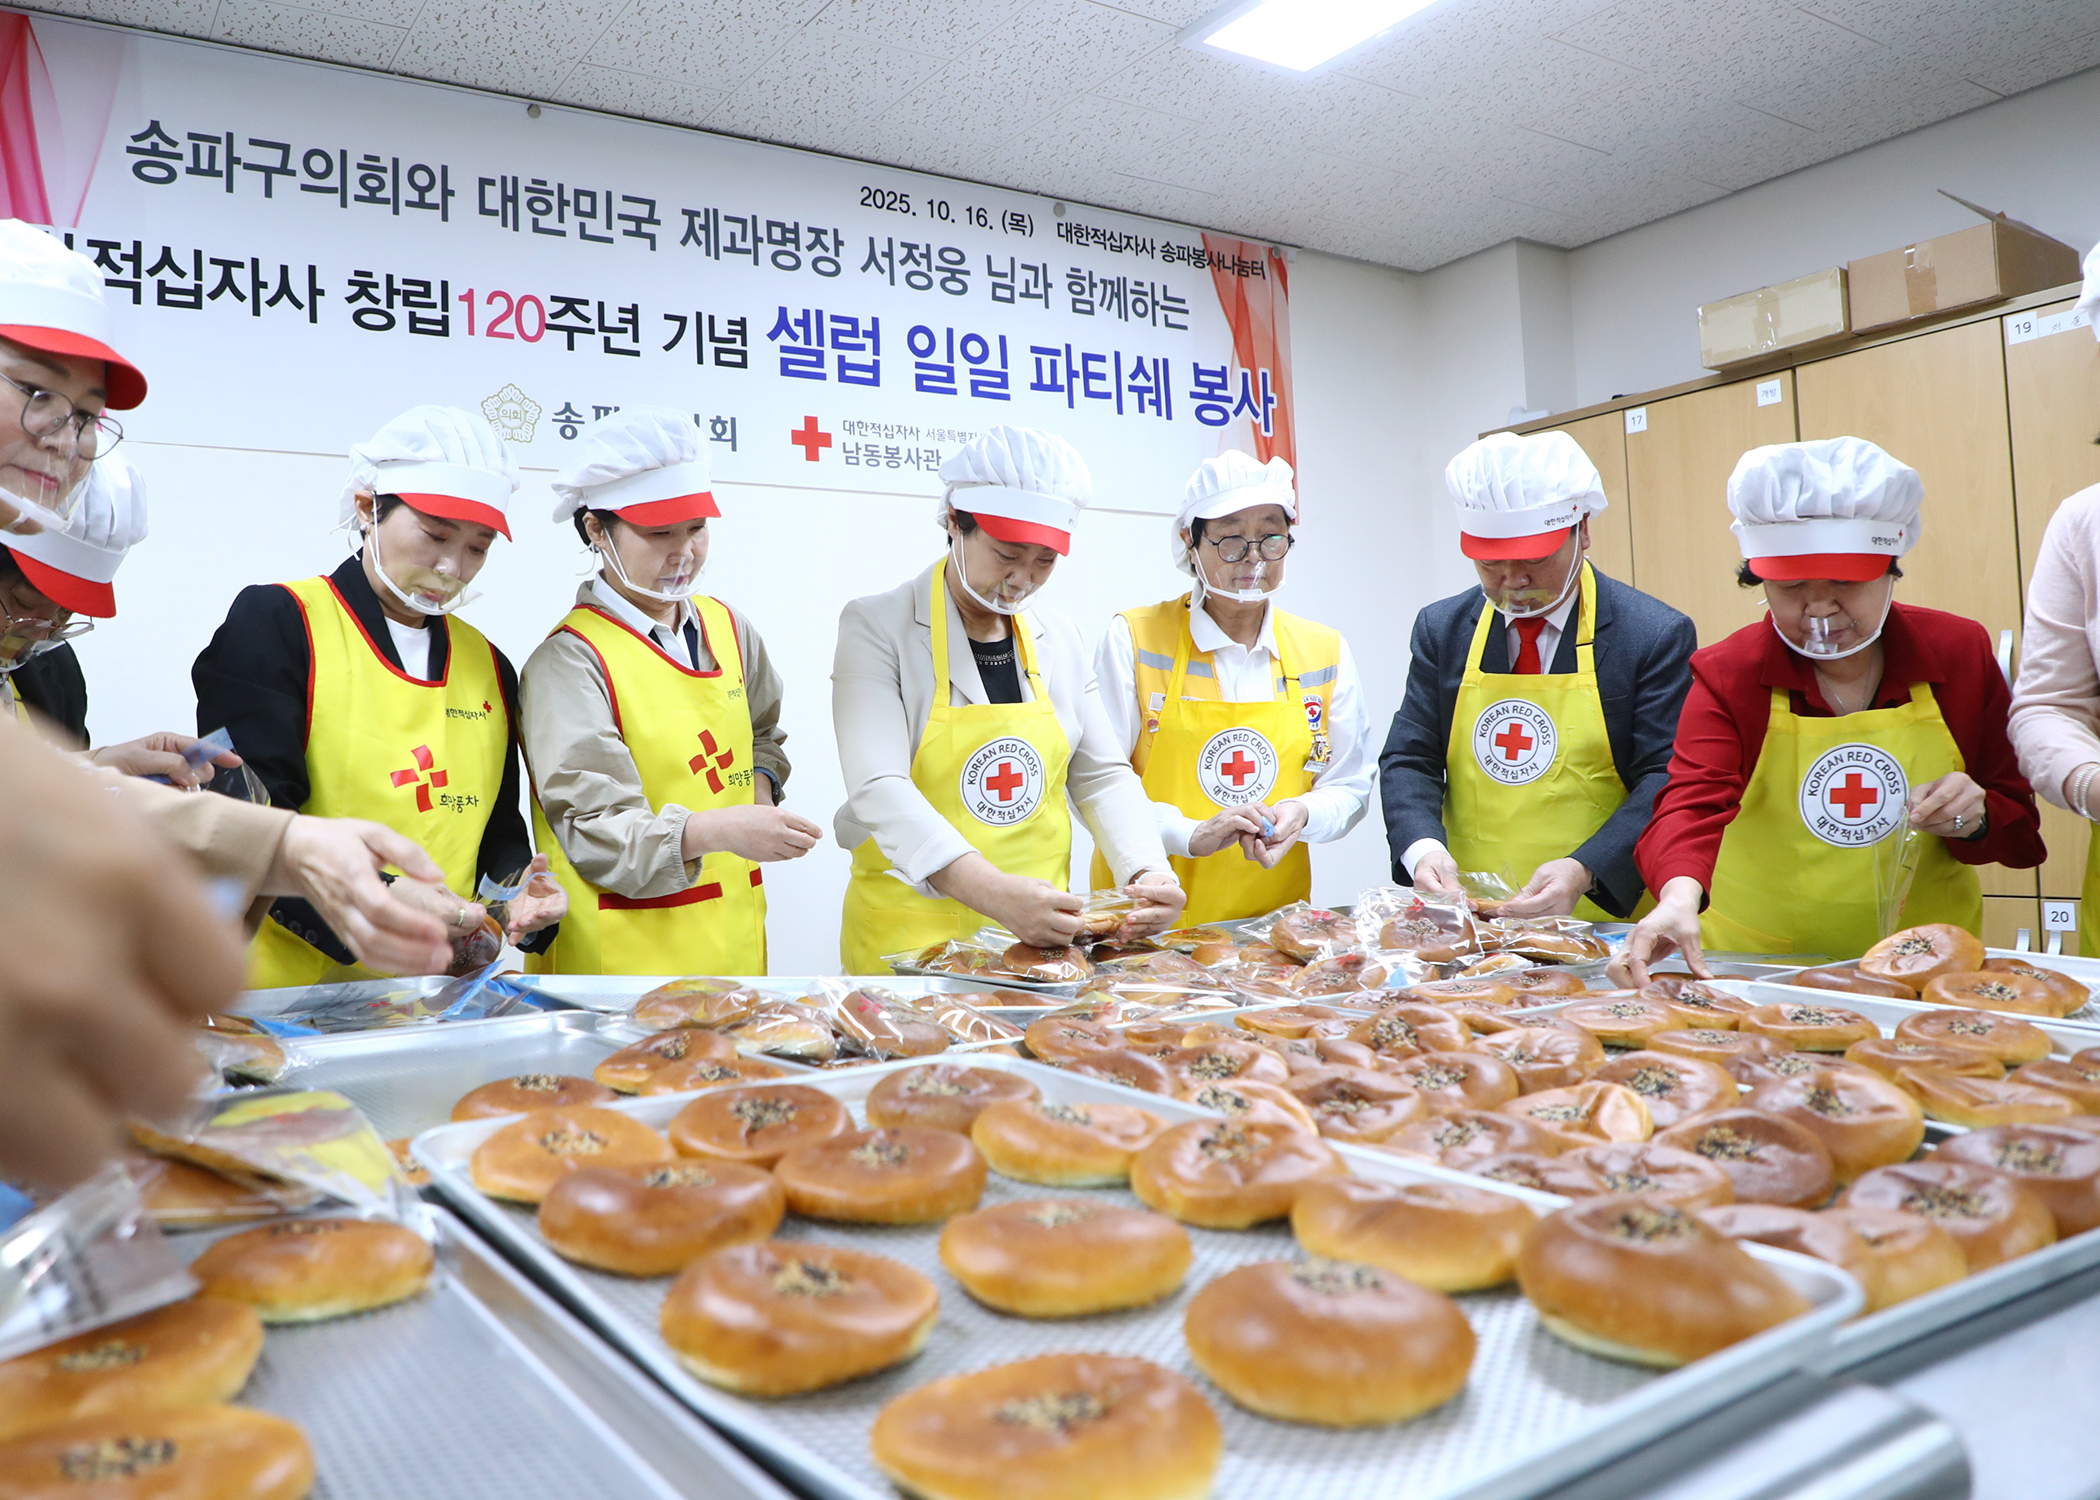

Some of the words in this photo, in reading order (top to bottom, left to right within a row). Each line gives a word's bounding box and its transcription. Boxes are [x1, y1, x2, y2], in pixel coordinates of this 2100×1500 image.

[860, 186, 917, 216] 2025.
[927, 199, 956, 223] 10.
[965, 206, 994, 230] 16.
[1001, 209, 1034, 238] (목)
[125, 119, 456, 222] 송파구의회와
[477, 174, 662, 251] 대한민국
[680, 206, 844, 278] 제과명장
[860, 236, 970, 296] 서정웅
[986, 254, 1053, 309] 님과
[1065, 266, 1190, 332] 함께하는
[1056, 221, 1156, 259] 대한적십자사
[1159, 241, 1267, 280] 송파봉사나눔터
[42, 231, 324, 323] 적십자사
[344, 268, 641, 357] 창립120주년
[663, 311, 748, 370] 기념
[766, 305, 881, 388] 셀럽
[906, 323, 1011, 402] 일일
[1030, 343, 1173, 421] 파티쉐
[1189, 361, 1275, 433] 봉사
[2014, 321, 2031, 334] 19
[501, 408, 523, 423] 의회
[1631, 415, 1643, 426] 17
[842, 419, 920, 442] 대한적십자사
[926, 428, 982, 445] 서울특별지
[842, 442, 942, 472] 남동봉사관
[1479, 706, 1510, 738] KOREAN
[1512, 705, 1533, 717] RED
[1532, 715, 1551, 746] CROSS
[967, 746, 997, 785] KOREAN
[999, 744, 1017, 753] RED
[1018, 747, 1039, 777] CROSS
[1204, 736, 1231, 770] KOREAN
[1233, 734, 1249, 742] RED
[1250, 738, 1272, 766] CROSS
[1484, 755, 1539, 780] 대한적십자사
[1808, 754, 1844, 796] KOREAN
[1847, 751, 1873, 763] RED
[1874, 759, 1901, 795] CROSS
[440, 793, 479, 813] 희망풍차
[1213, 783, 1265, 804] 대한적십자사
[976, 797, 1033, 821] 대한적십자사
[1816, 816, 1890, 841] 대한적십자사
[2051, 911, 2069, 923] 20
